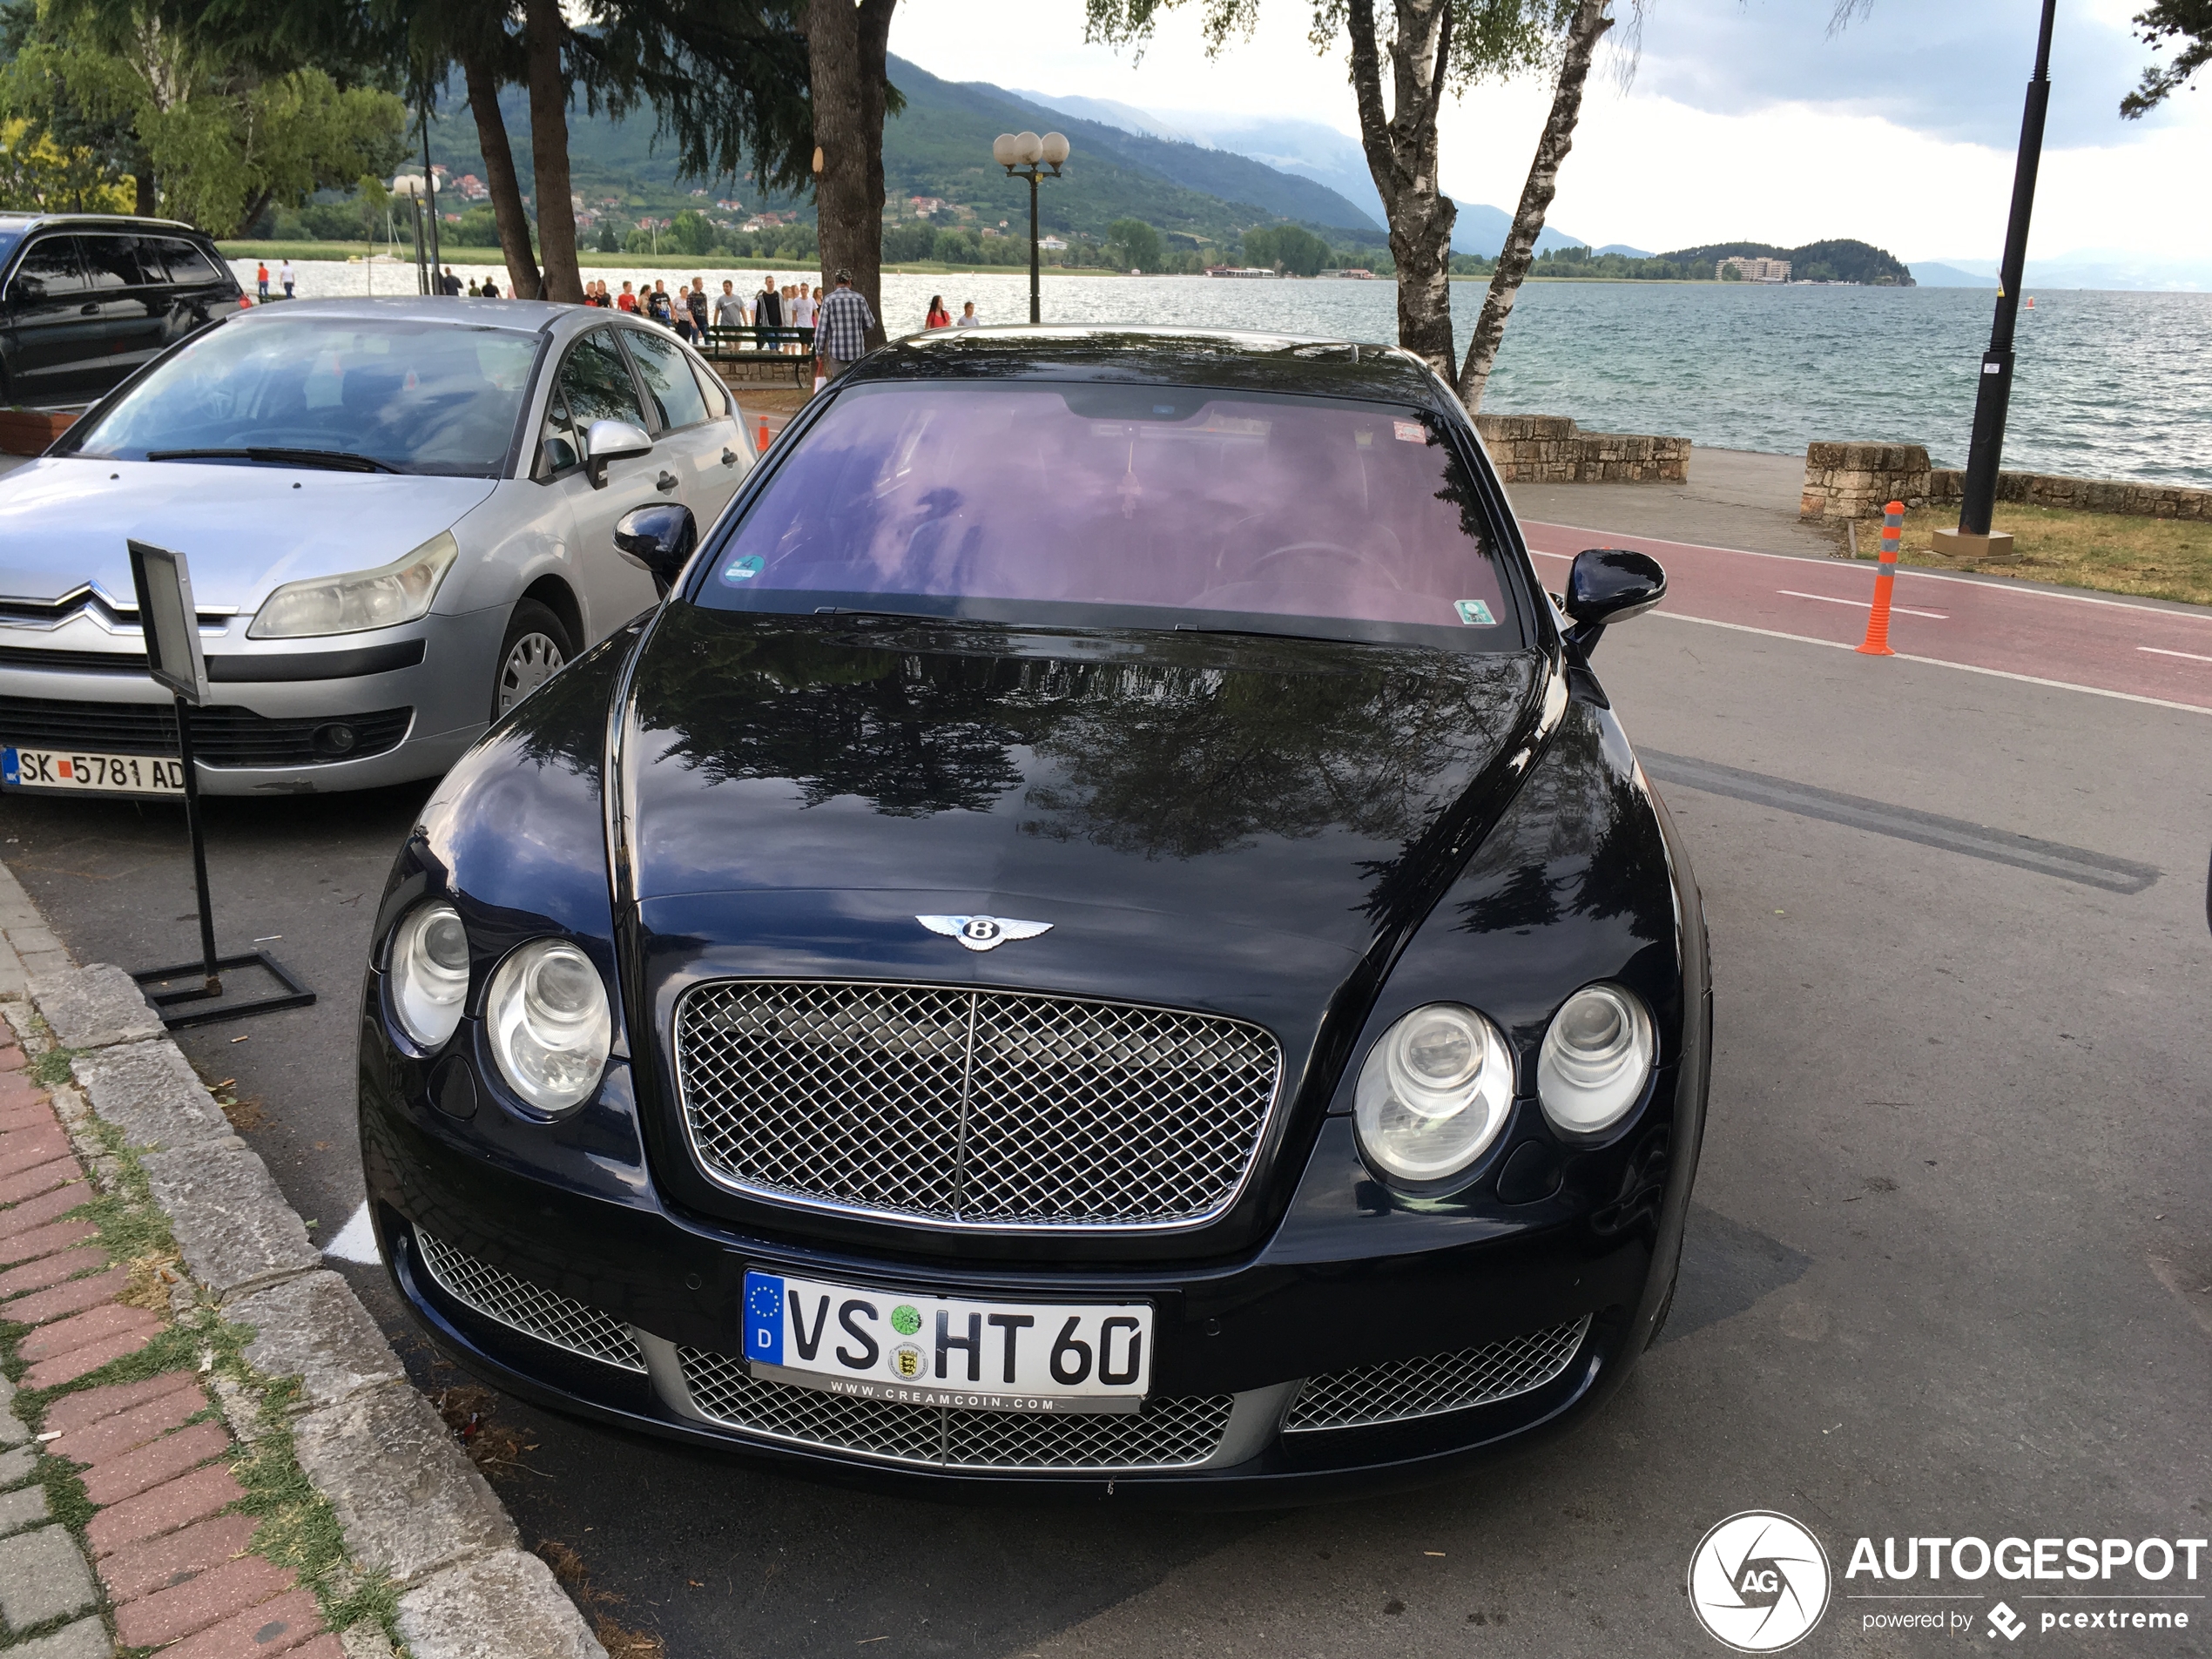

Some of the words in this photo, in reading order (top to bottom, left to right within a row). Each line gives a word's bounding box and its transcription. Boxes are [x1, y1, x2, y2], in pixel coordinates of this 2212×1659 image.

[742, 556, 756, 569] 4
[21, 752, 55, 782] SK
[72, 756, 141, 786] 5781
[152, 761, 185, 788] AD
[968, 920, 993, 939] B
[758, 1328, 772, 1348] D
[788, 1290, 879, 1369] VS
[934, 1309, 1035, 1383] HT
[1049, 1316, 1141, 1386] 60
[831, 1380, 1053, 1410] WWW.CREAMCOIN.COM
